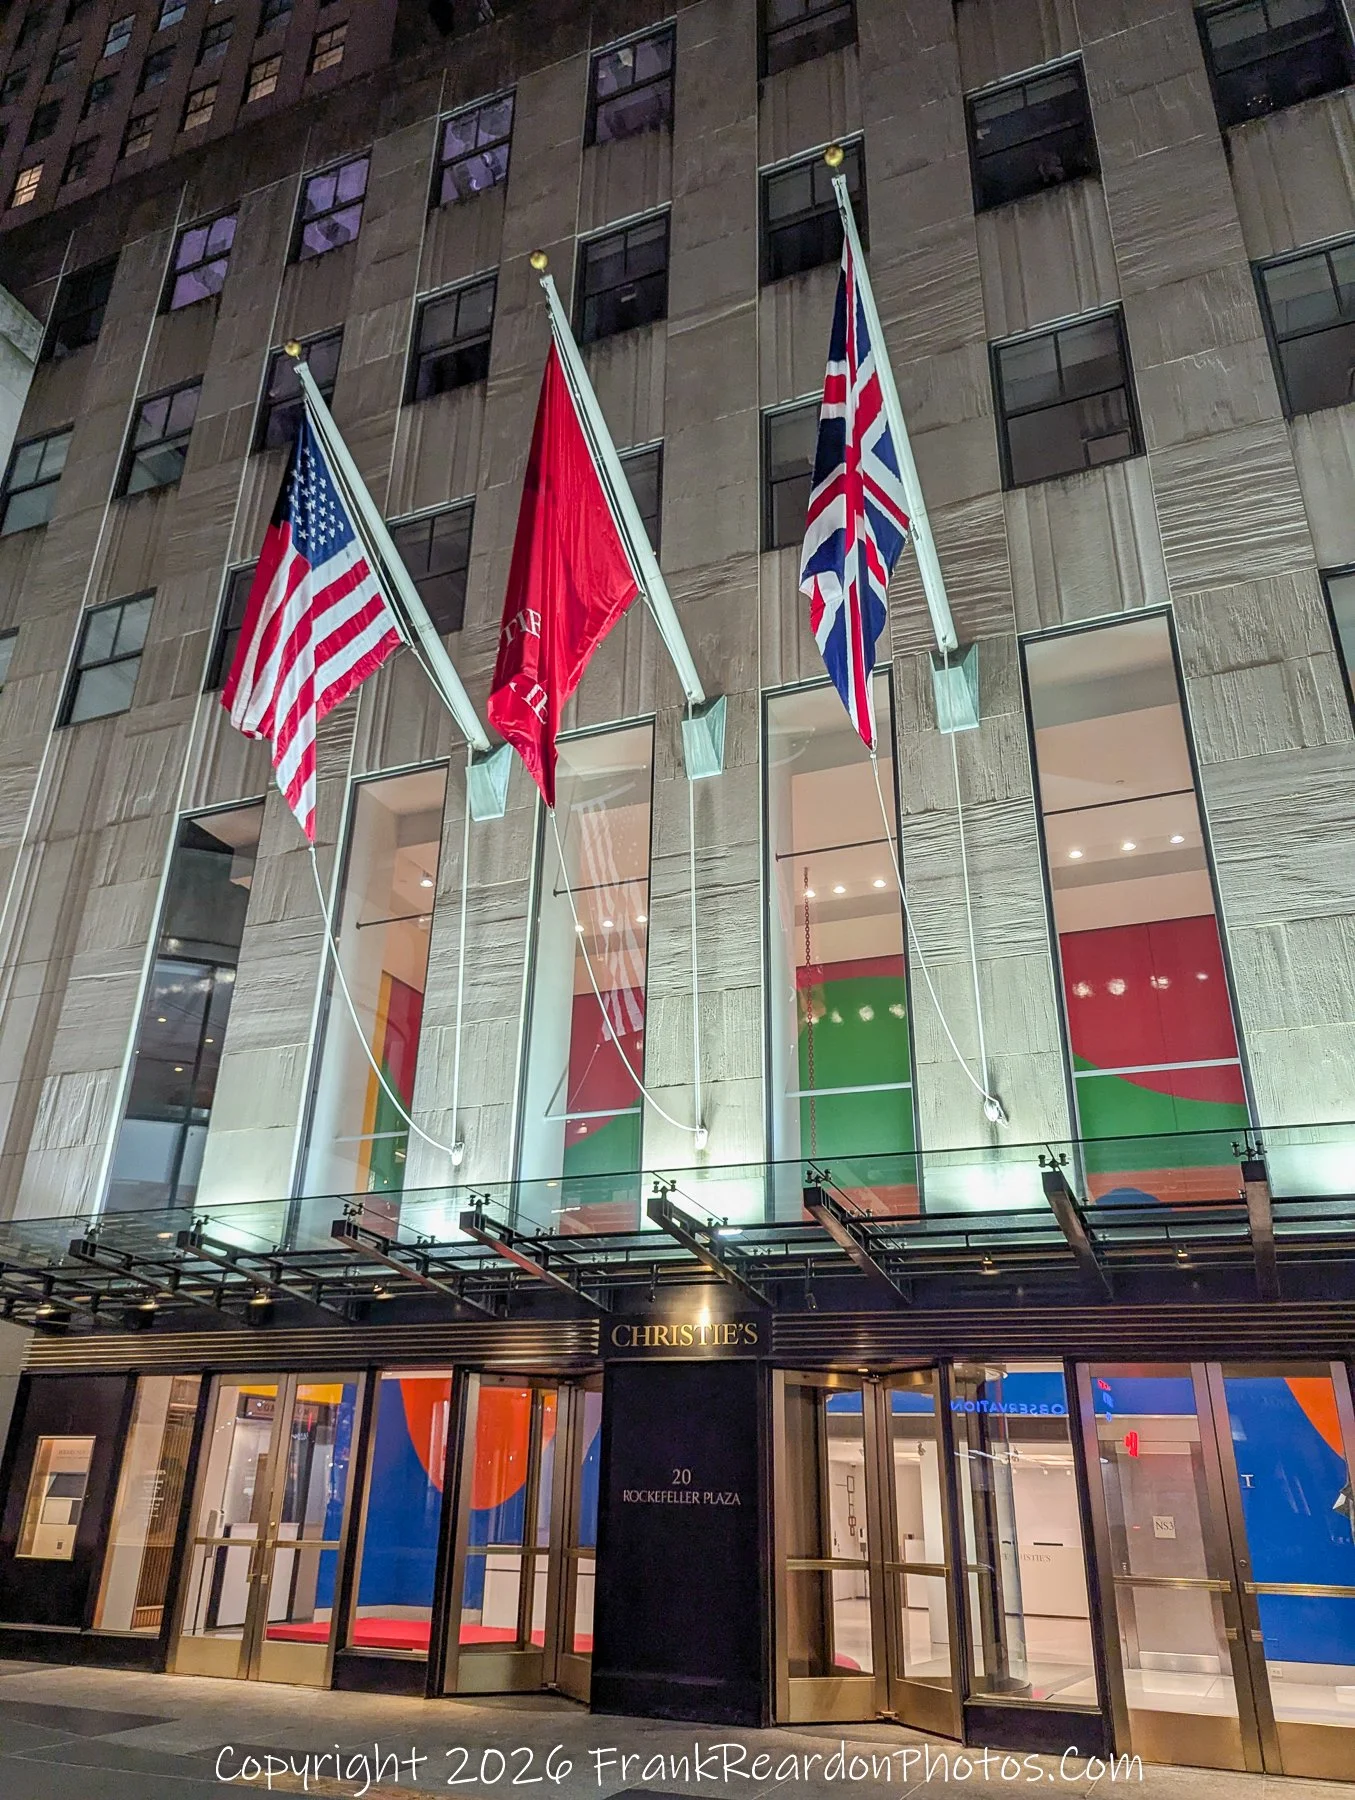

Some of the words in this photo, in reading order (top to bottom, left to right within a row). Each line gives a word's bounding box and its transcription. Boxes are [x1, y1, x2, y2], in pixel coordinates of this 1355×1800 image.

[611, 1323, 759, 1348] CHRISTIE'S
[672, 1468, 691, 1485] 20
[623, 1489, 700, 1504] ROCKEFELLER
[703, 1491, 741, 1506] PLAZA
